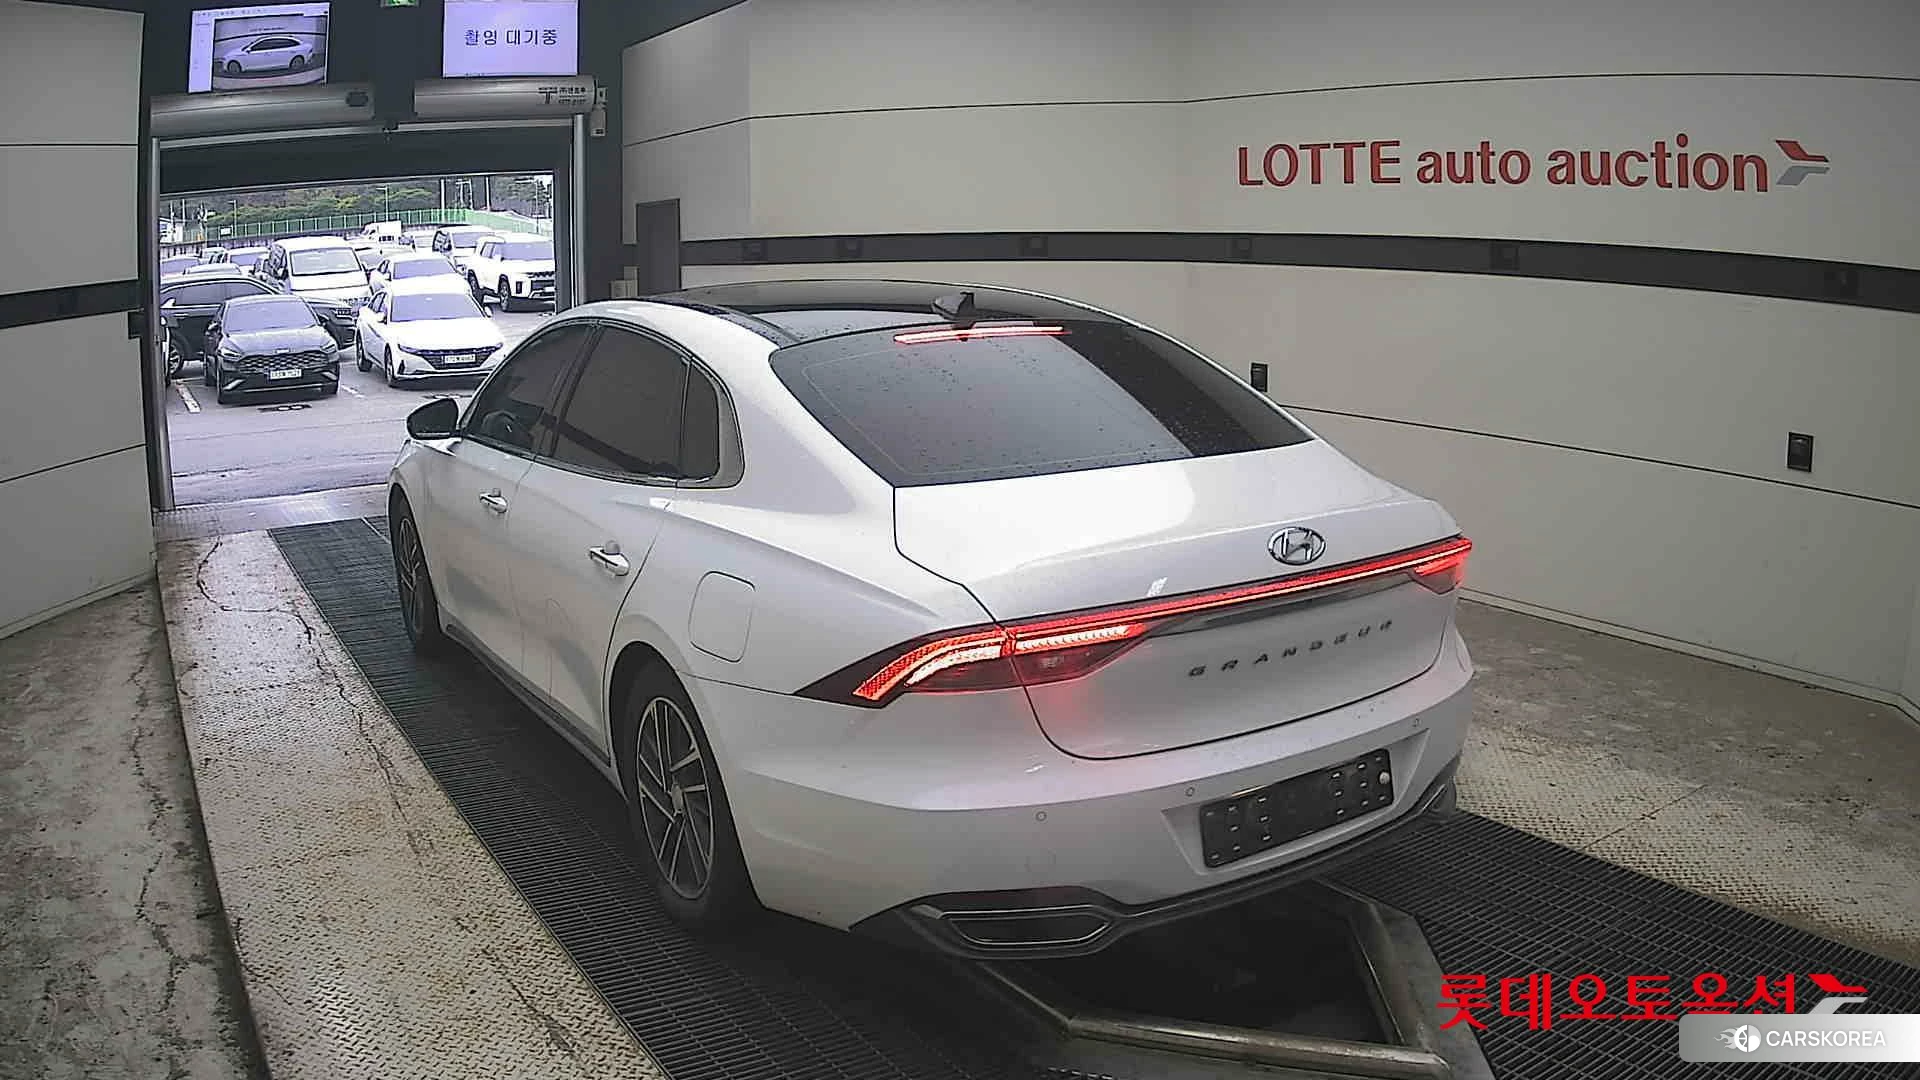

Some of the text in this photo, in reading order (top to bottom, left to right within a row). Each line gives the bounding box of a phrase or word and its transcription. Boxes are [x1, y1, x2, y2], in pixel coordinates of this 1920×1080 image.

[506, 29, 558, 46] 대기중
[1238, 133, 1768, 192] LOTTE auto auction
[1188, 619, 1393, 677] GRANDEUR
